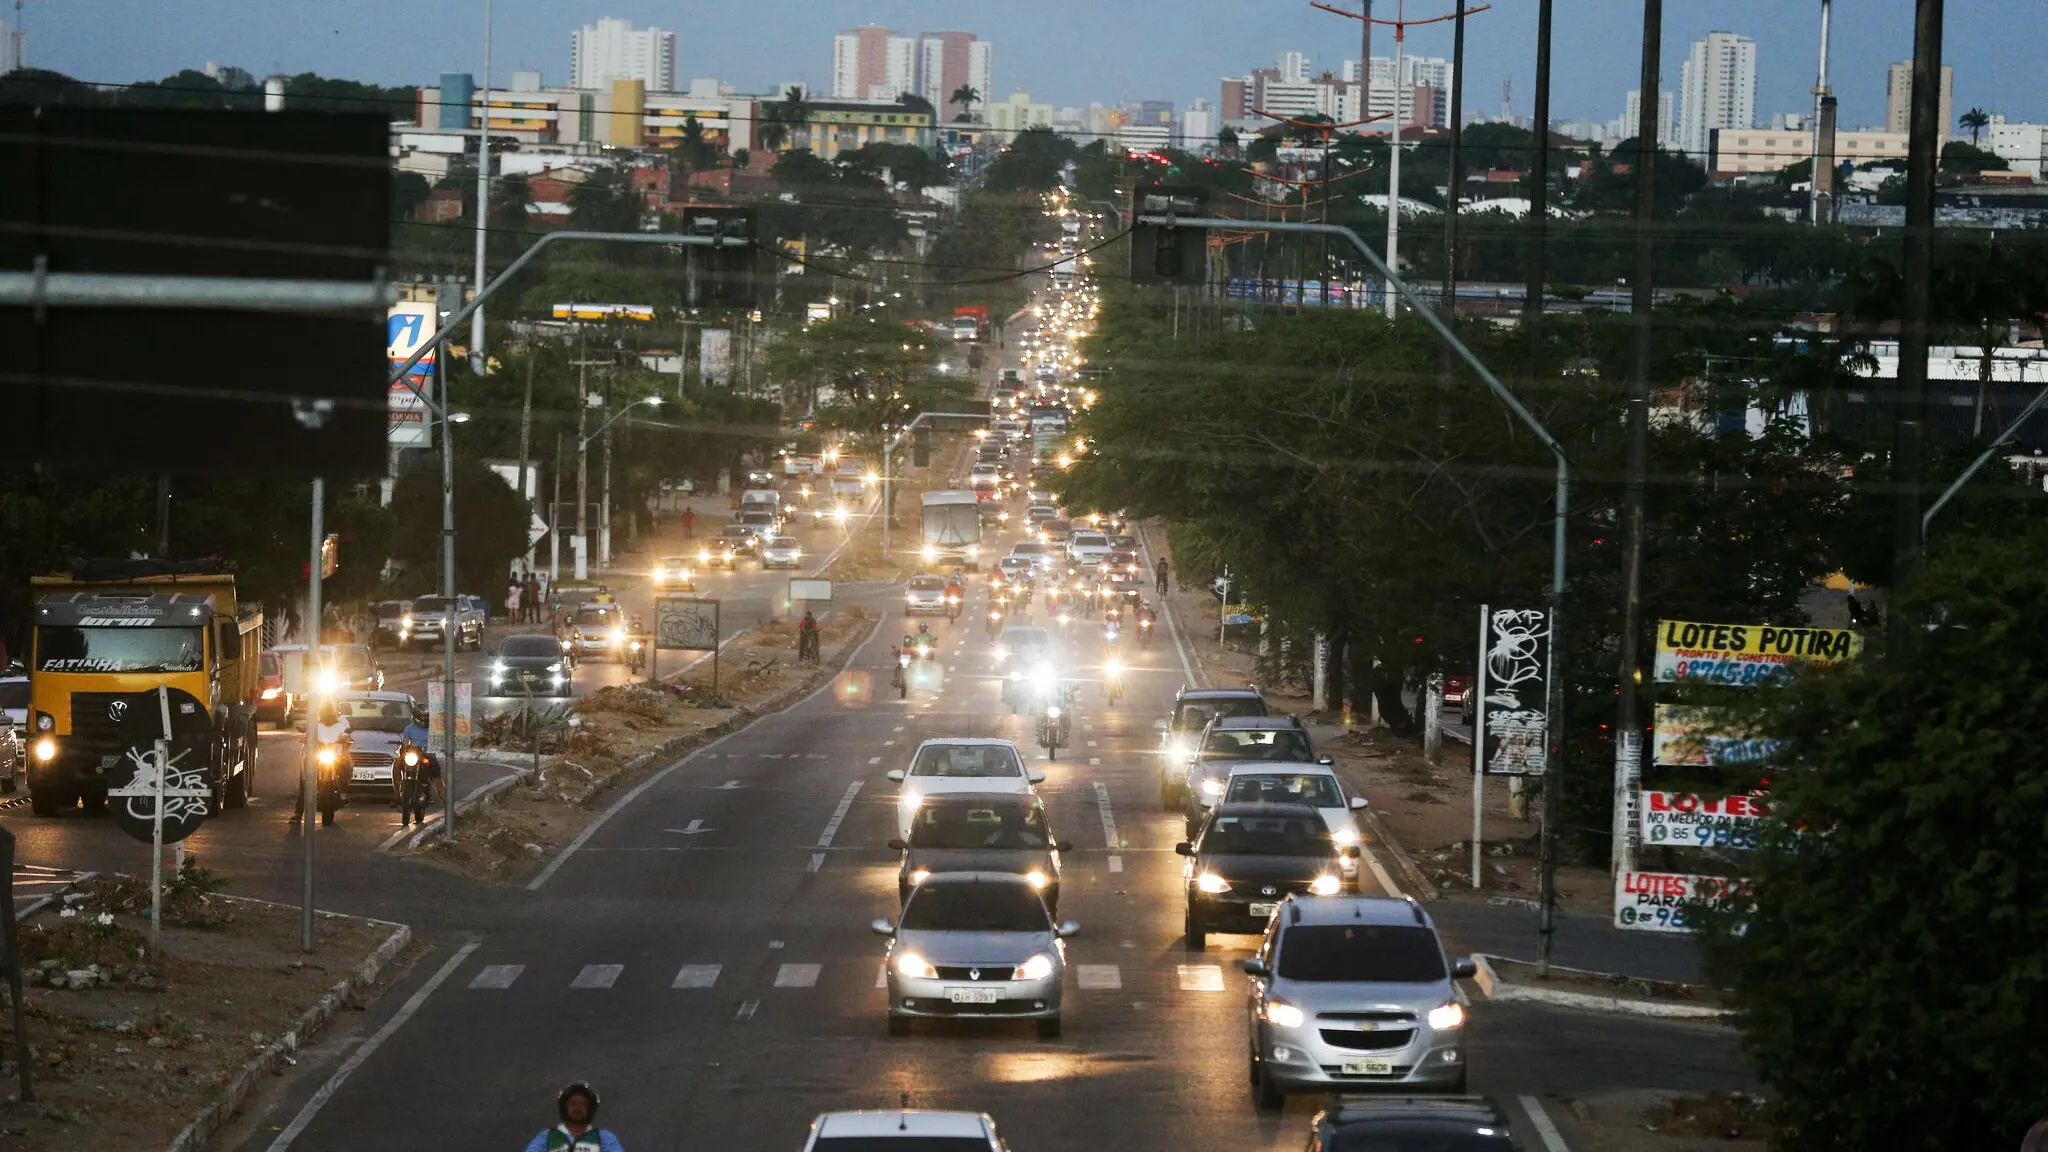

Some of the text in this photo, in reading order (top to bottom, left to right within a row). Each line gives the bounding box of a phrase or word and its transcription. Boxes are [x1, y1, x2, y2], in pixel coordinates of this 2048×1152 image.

[1666, 622, 1851, 658] LOTES POTIRA
[1676, 648, 1718, 659] PRONTO
[42, 658, 123, 672] FATINHA
[1650, 792, 1768, 818] LOTES
[1647, 812, 1664, 824] NO
[1667, 812, 1714, 826] MELHOR
[1672, 828, 1689, 839] 85
[1624, 872, 1689, 896] LOTES
[1637, 893, 1686, 909] PARA
[1638, 912, 1653, 923] 85
